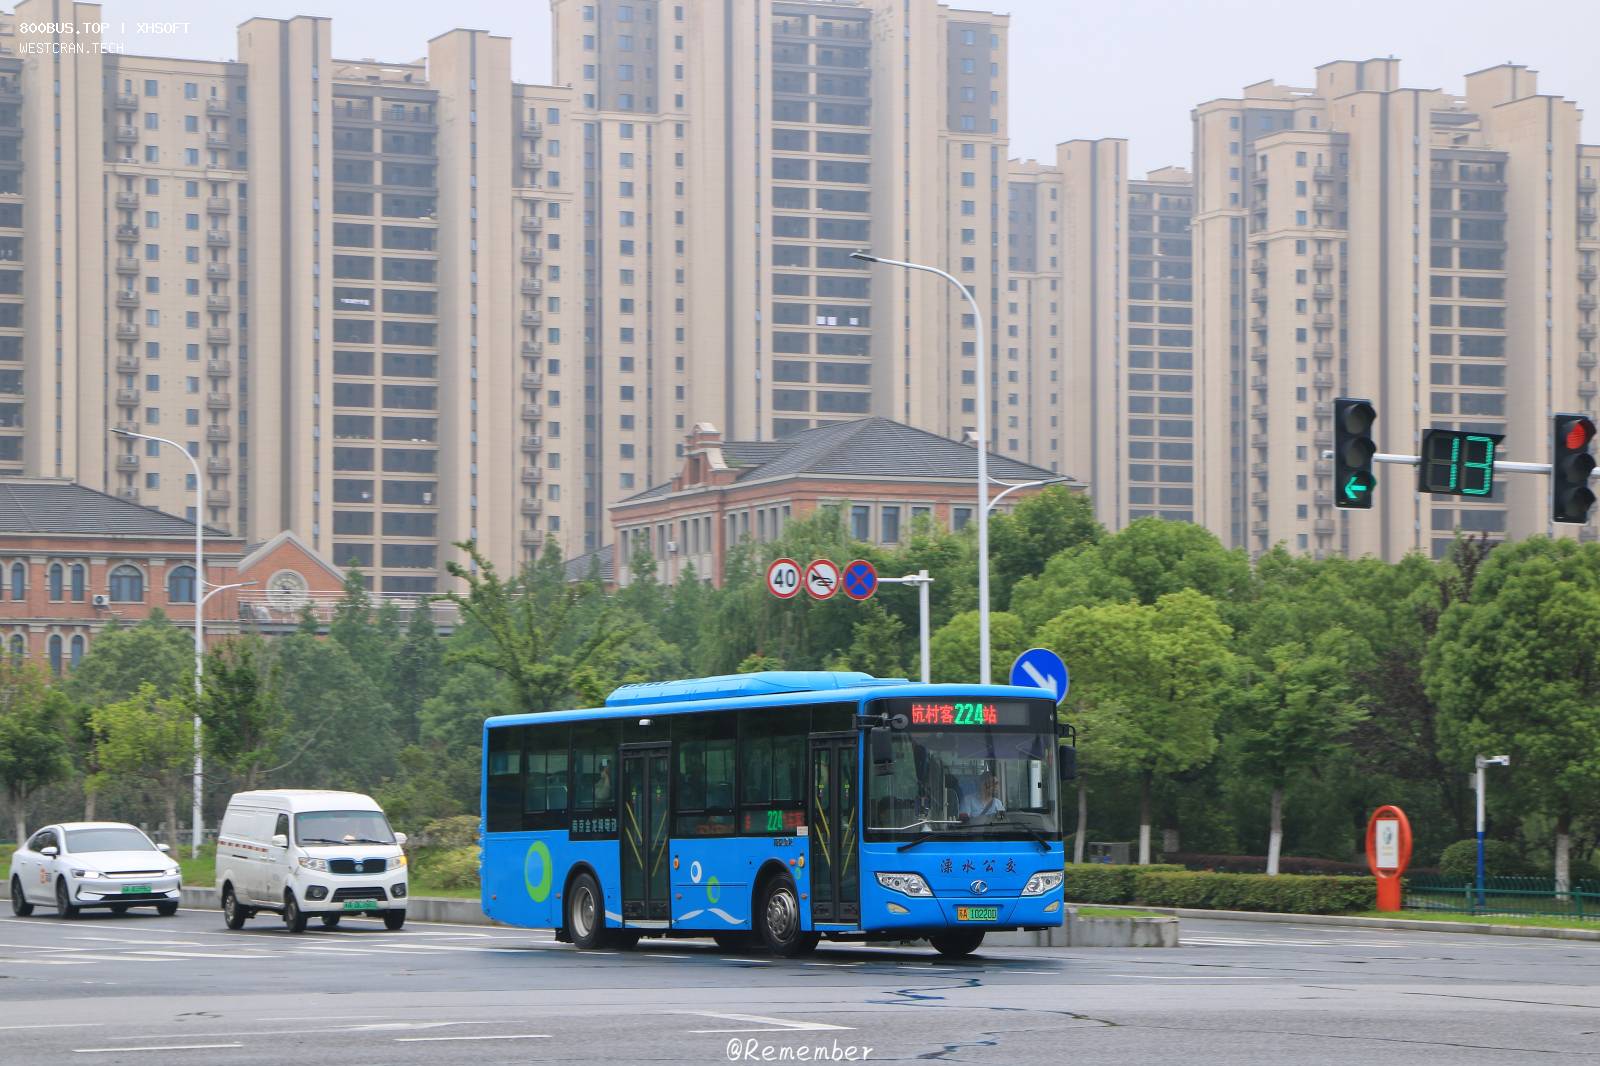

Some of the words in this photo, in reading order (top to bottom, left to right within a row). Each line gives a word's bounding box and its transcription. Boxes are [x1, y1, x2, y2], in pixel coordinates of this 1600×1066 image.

[774, 569, 796, 588] 40
[767, 810, 783, 831] 224
[940, 857, 1017, 873] 溧水公交
